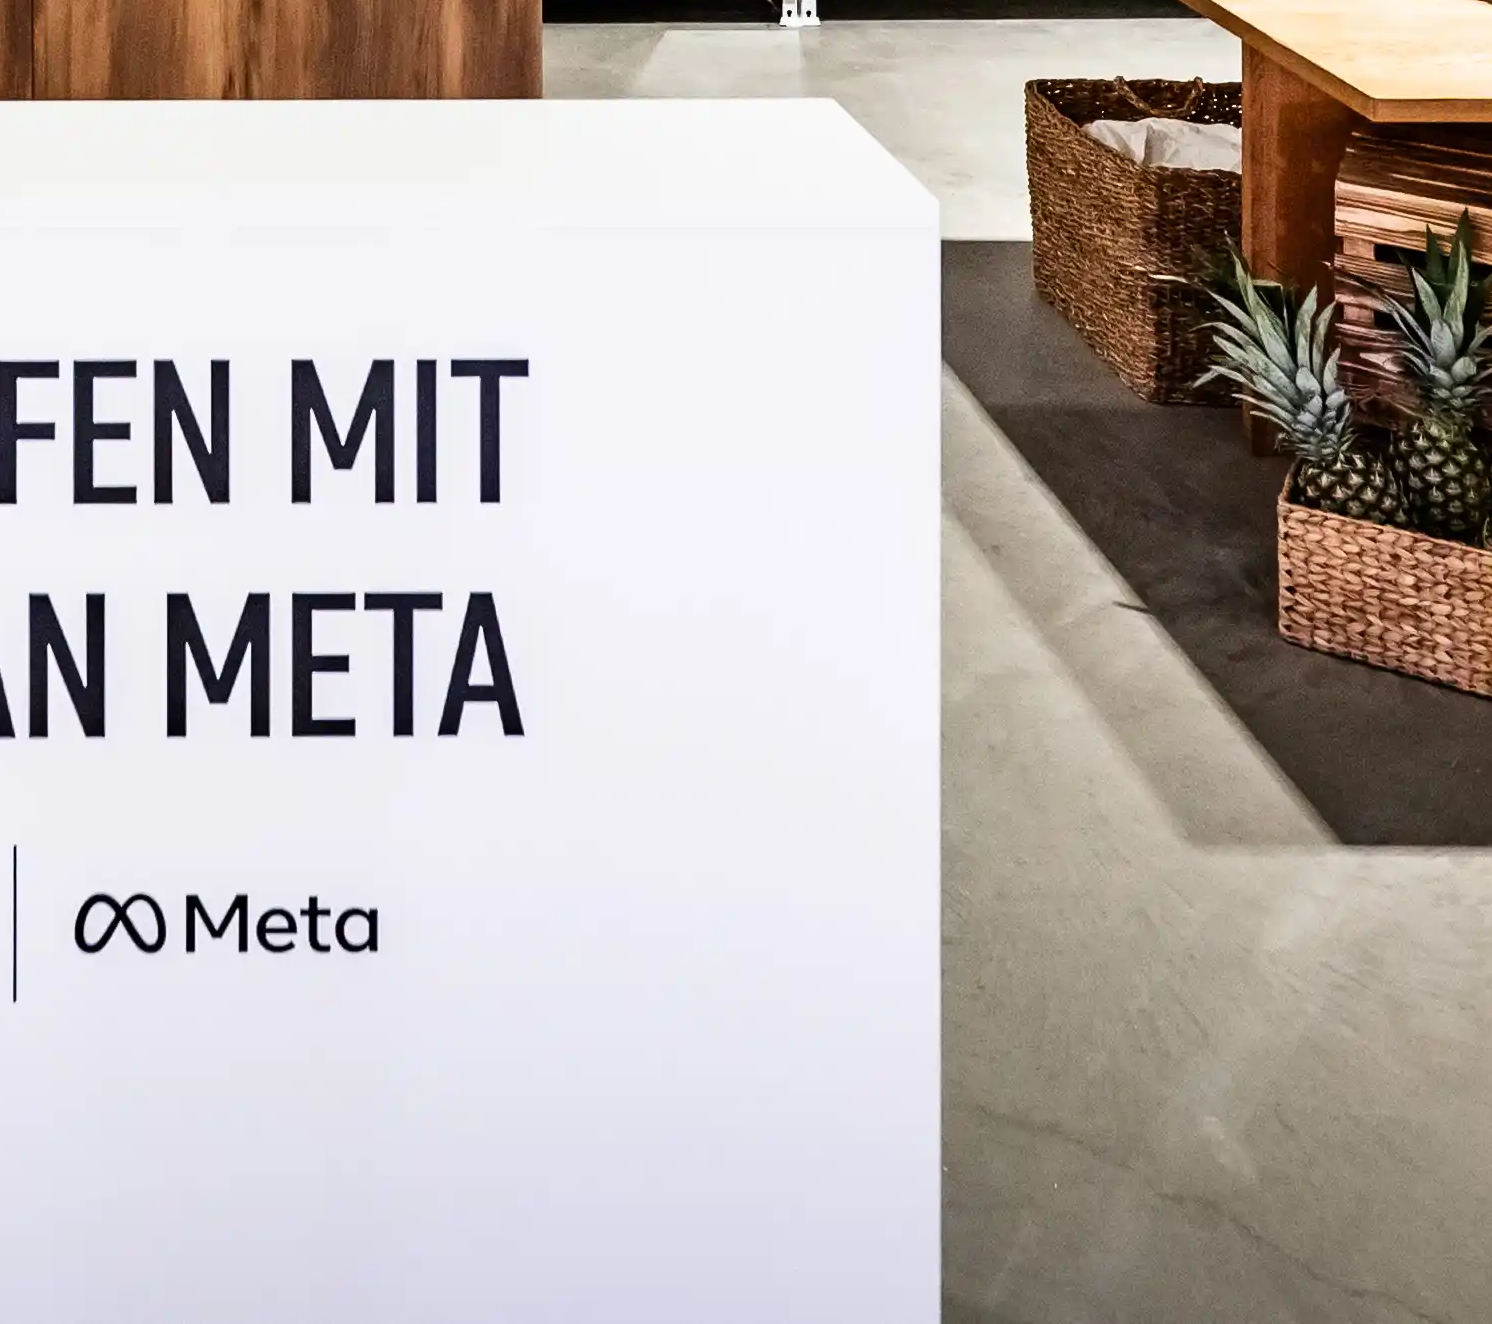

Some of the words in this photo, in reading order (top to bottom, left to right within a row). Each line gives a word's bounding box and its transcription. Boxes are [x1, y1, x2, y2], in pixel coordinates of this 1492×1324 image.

[292, 359, 529, 503] MIT
[167, 592, 524, 737] META
[186, 895, 378, 952] Meta
